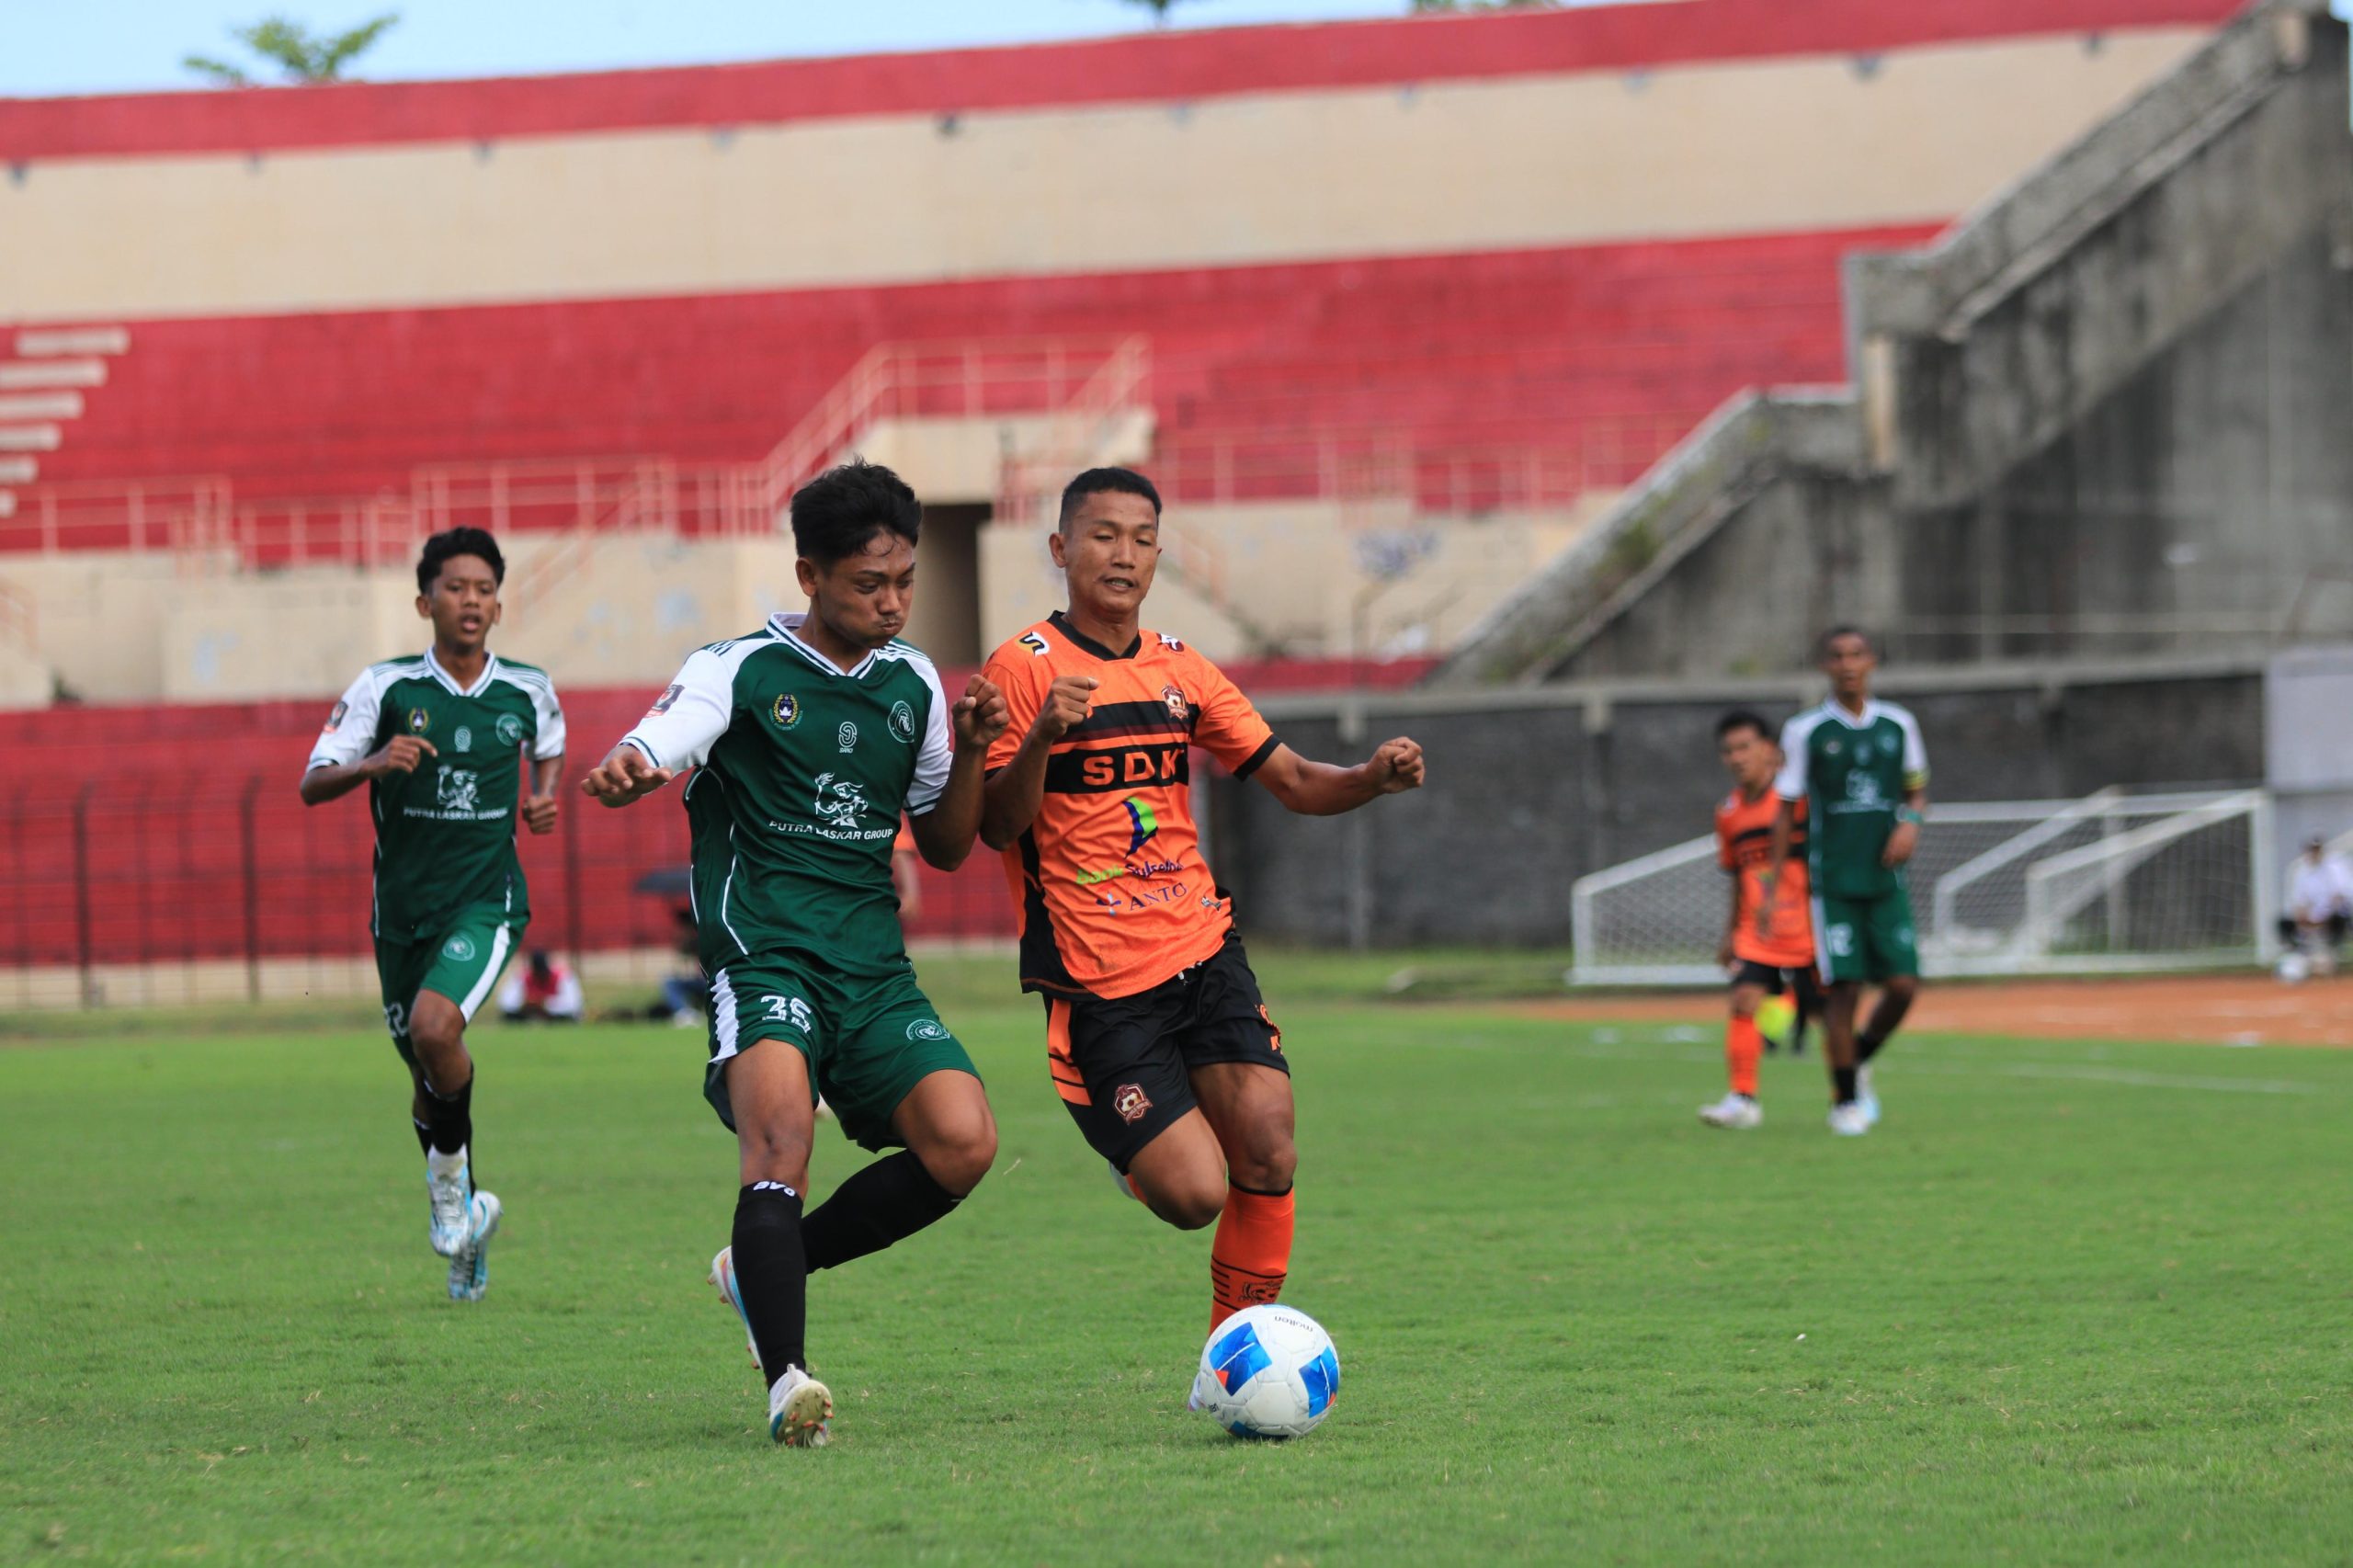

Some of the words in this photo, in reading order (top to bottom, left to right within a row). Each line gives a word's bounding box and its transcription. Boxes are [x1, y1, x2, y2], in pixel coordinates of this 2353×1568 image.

[768, 820, 813, 834] PUTRA
[815, 827, 862, 841] LASKAR
[864, 828, 893, 840] GROUP
[760, 995, 812, 1034] 35
